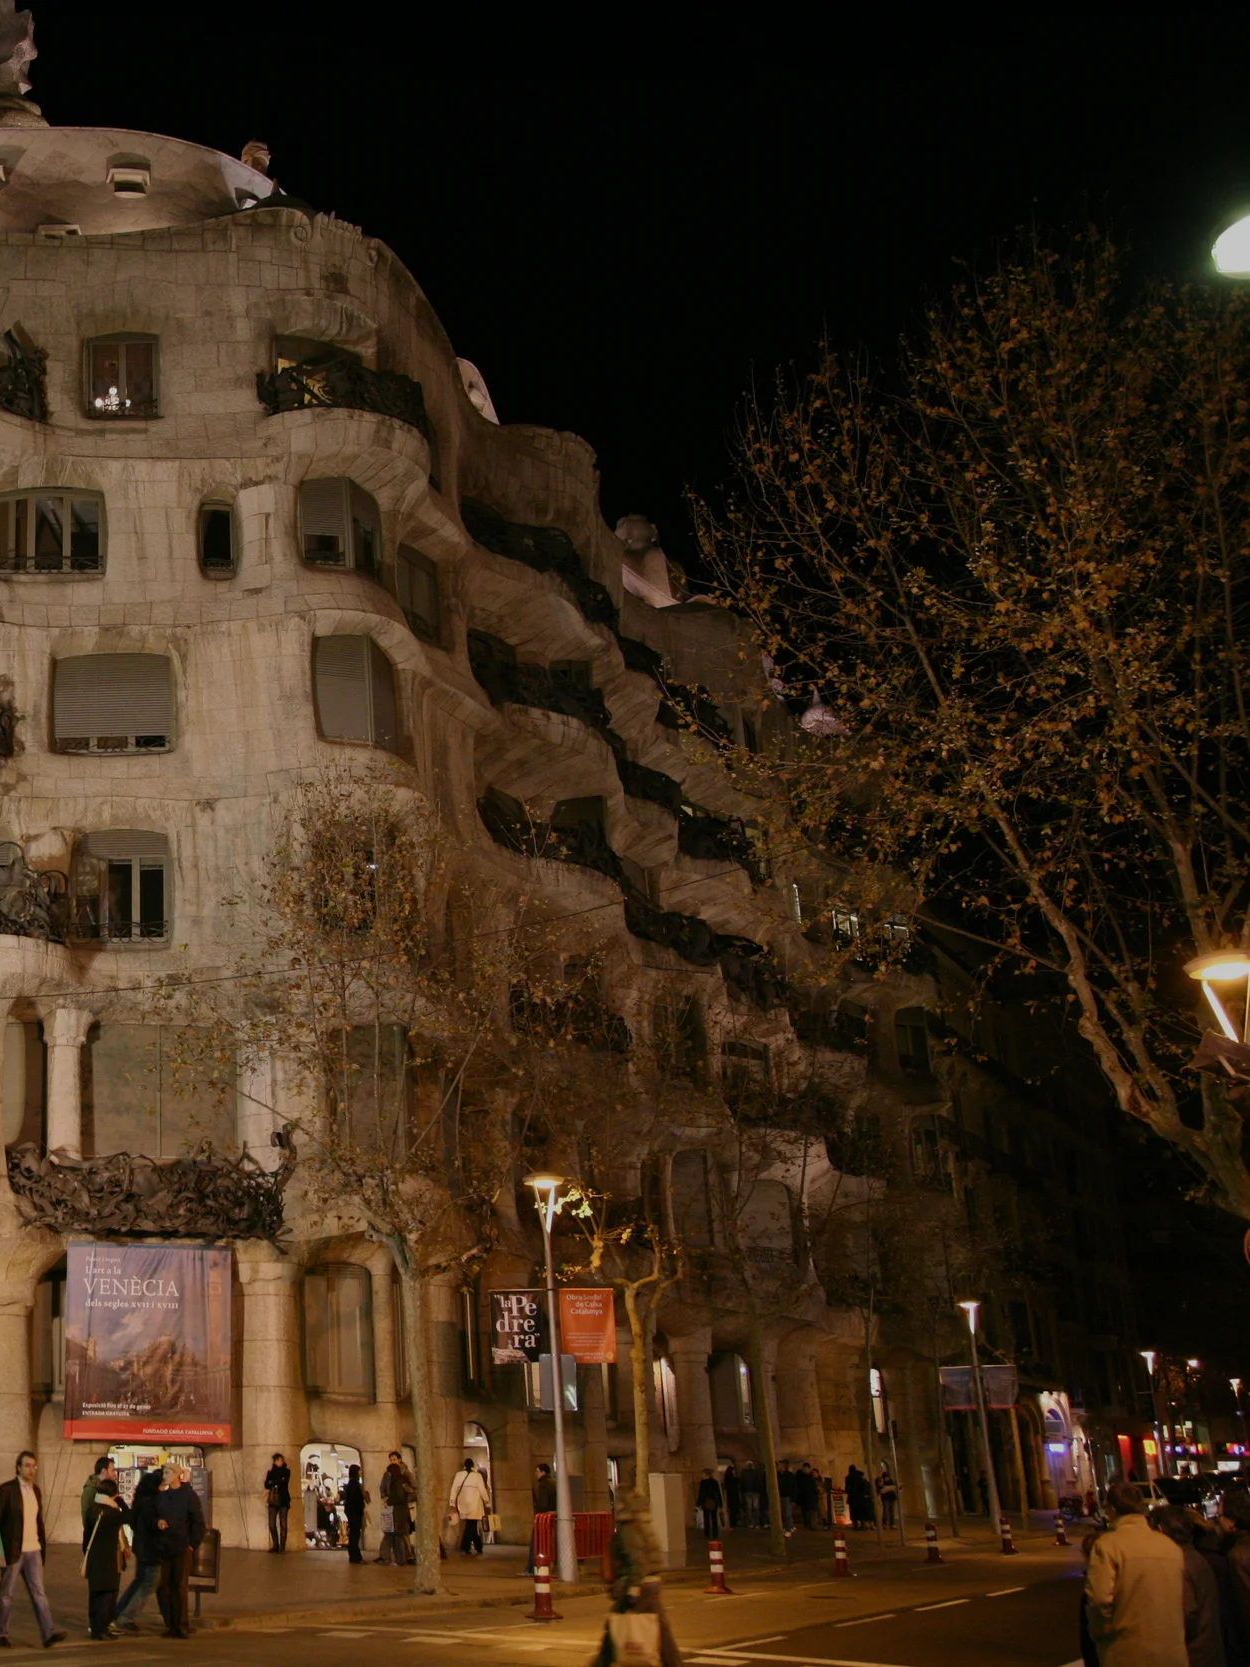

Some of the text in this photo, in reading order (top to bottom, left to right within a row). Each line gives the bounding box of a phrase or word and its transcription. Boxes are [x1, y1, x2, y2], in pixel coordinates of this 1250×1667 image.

[113, 1265, 121, 1275] la
[82, 1276, 180, 1297] VENÈCIA
[85, 1298, 102, 1307] dels
[103, 1299, 129, 1310] segles
[510, 1295, 538, 1316] Pe
[570, 1308, 603, 1316] Catalunya
[495, 1311, 536, 1333] dre
